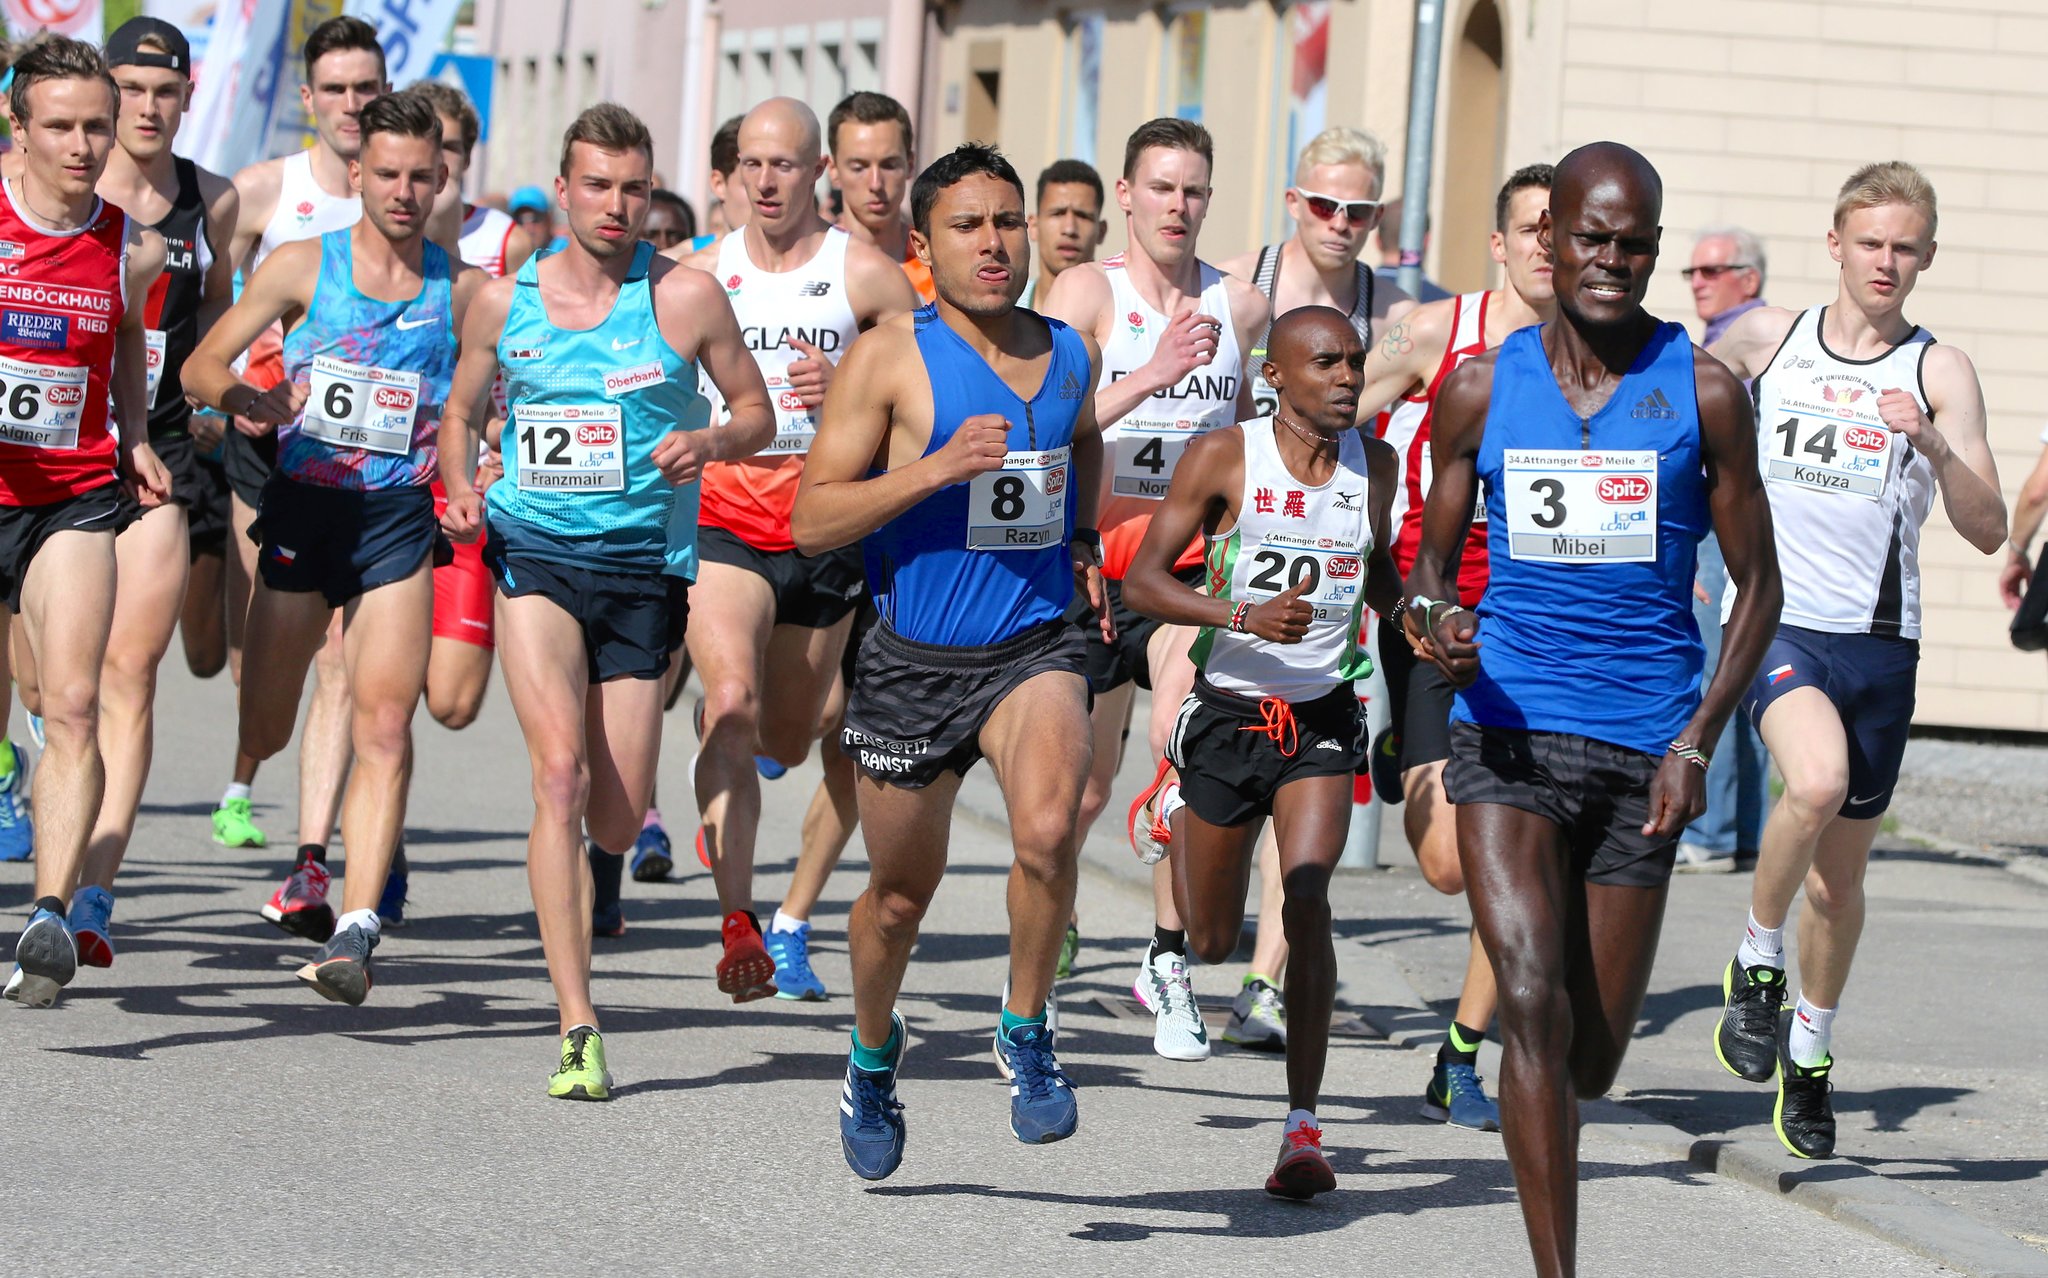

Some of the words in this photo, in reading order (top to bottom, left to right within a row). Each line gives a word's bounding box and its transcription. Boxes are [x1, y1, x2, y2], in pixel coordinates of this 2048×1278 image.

[7, 312, 62, 331] RIEDER
[77, 317, 108, 333] RIED
[743, 327, 840, 352] GLAND
[1, 362, 37, 374] ttnanger
[607, 368, 663, 390] Oberbank
[1826, 374, 1862, 384] UNIVERZITA
[1862, 380, 1878, 395] BRNO
[0, 379, 41, 420] 6
[50, 388, 80, 403] Spitz
[324, 382, 354, 419] 6
[378, 390, 410, 406] Spitz
[1631, 407, 1680, 420] adidas
[1855, 412, 1879, 422] Meile
[0, 424, 51, 442] Aigner
[340, 427, 368, 442] Fris
[579, 427, 613, 443] Spitz
[1776, 417, 1838, 464] 14
[1847, 429, 1884, 448] Spitz
[521, 426, 572, 466] 12
[1133, 437, 1165, 475] 4
[1508, 455, 1578, 466] 34.Attnanger
[1605, 456, 1635, 465] Meile
[531, 472, 604, 486] Franzmair
[1047, 472, 1064, 491] Spitz
[1794, 466, 1850, 489] Kotyza
[1138, 481, 1170, 494] Nor
[1601, 479, 1646, 500] Spitz
[991, 476, 1025, 521] 8
[1253, 487, 1306, 519] 世羅
[1529, 478, 1567, 529] 3
[1600, 522, 1631, 531] LCAV
[1005, 528, 1050, 545] Razyn
[1334, 540, 1354, 549] Meile
[1552, 538, 1605, 555] Mibei
[1248, 551, 1321, 595] 20
[1330, 559, 1357, 575] Spitz
[860, 749, 914, 773] RANST
